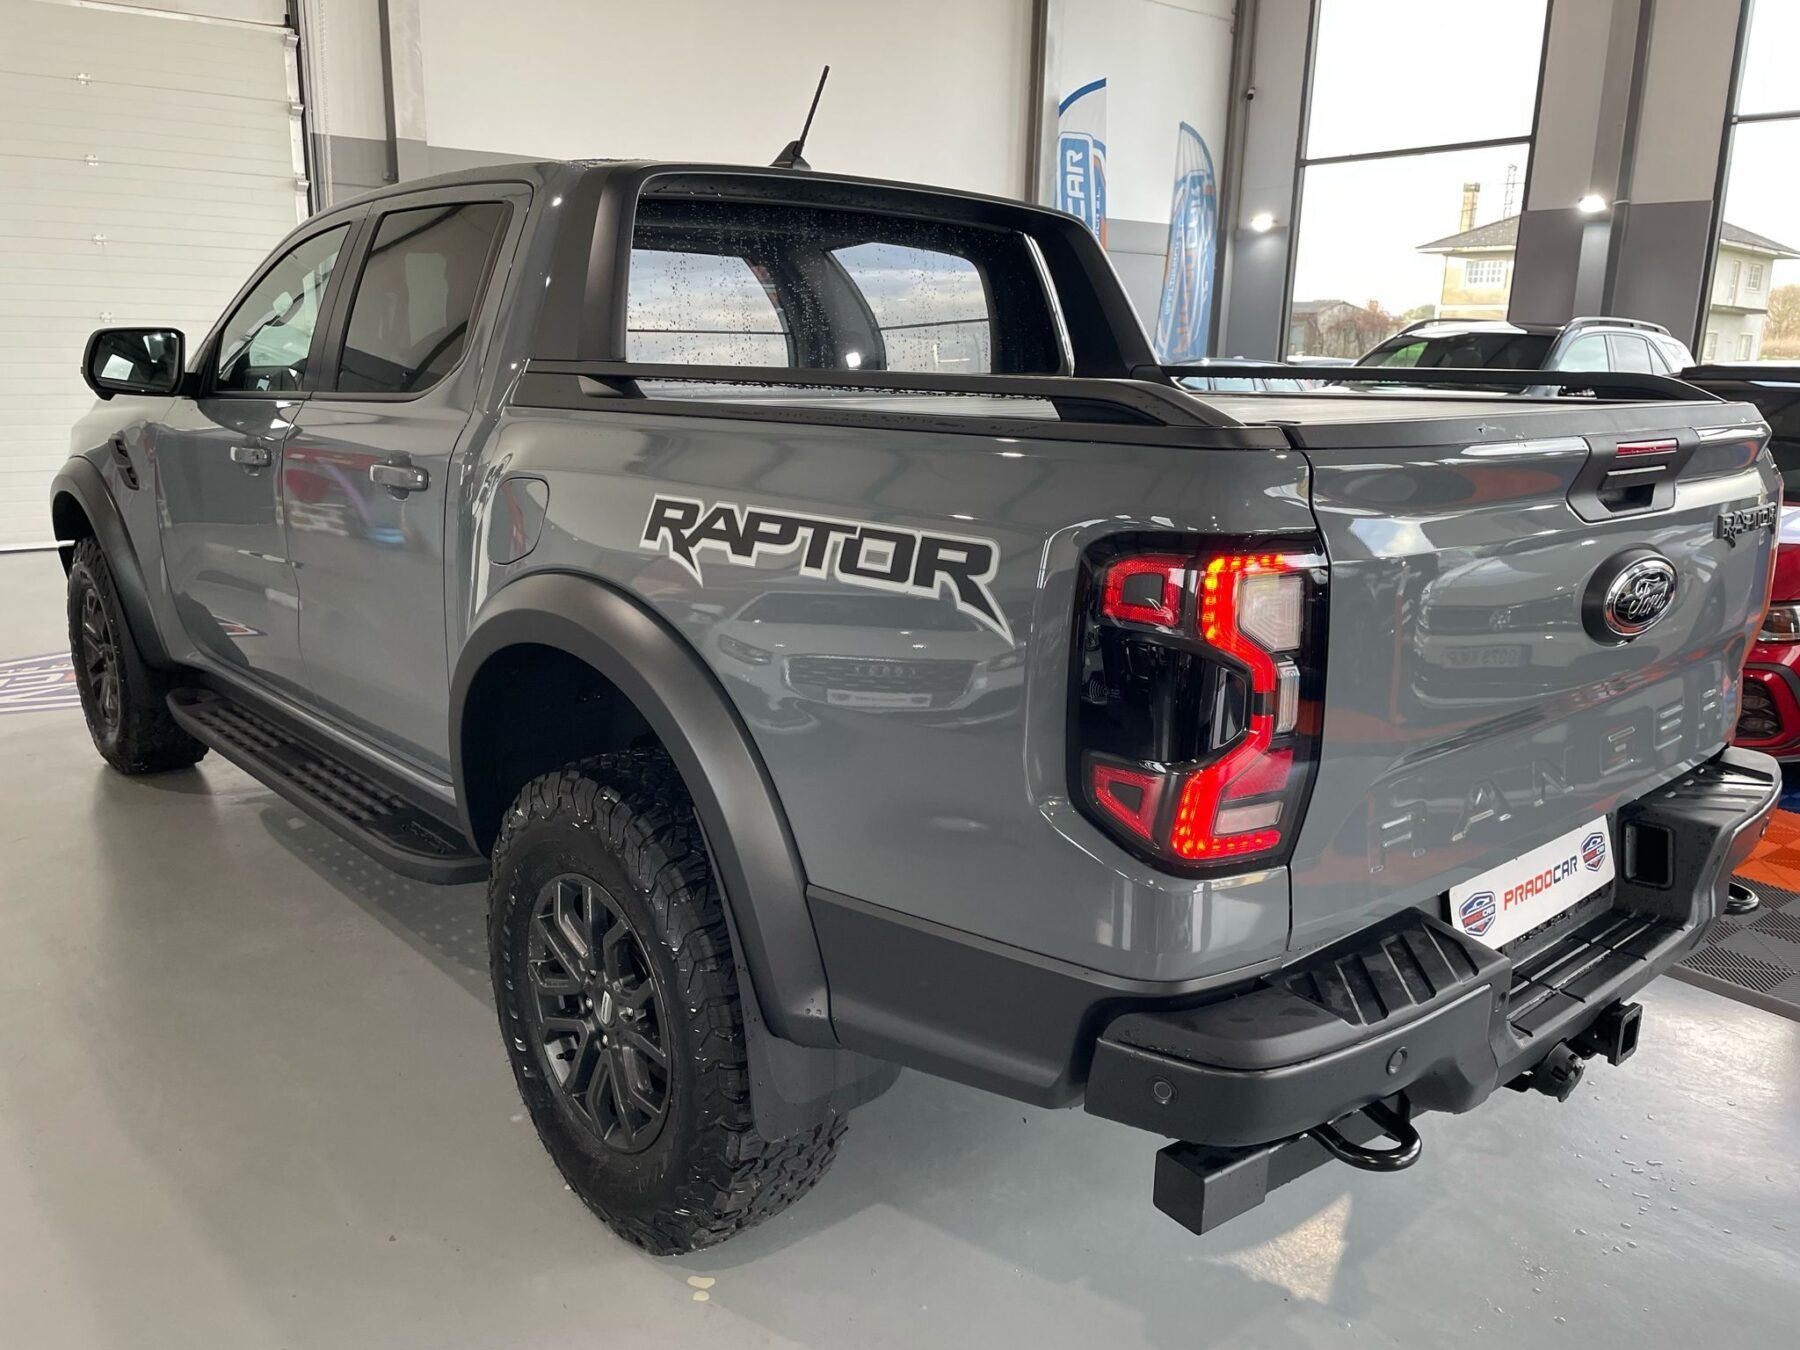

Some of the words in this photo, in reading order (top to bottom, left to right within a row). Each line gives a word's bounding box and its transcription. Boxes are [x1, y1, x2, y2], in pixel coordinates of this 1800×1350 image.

[1713, 502, 1777, 548] RAPTOR
[639, 493, 1014, 649] RAPTOR
[1628, 575, 1670, 619] Ford
[1504, 855, 1578, 911] PRADOCAR
